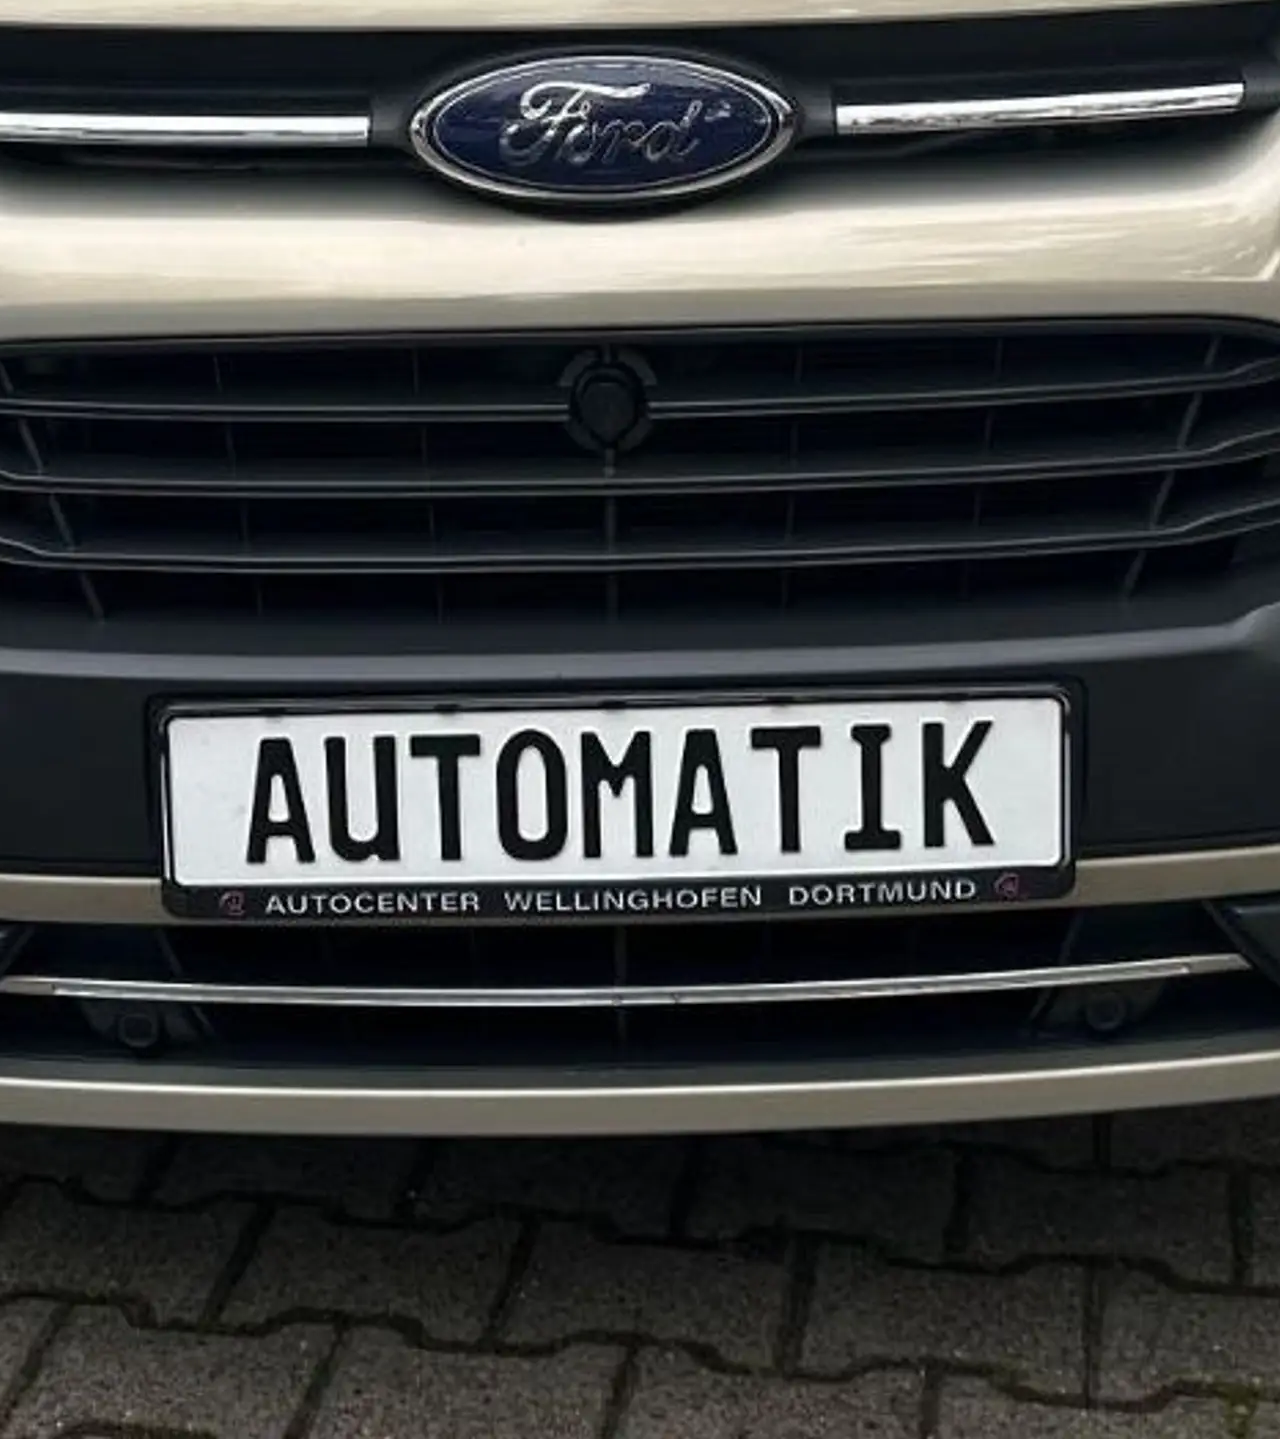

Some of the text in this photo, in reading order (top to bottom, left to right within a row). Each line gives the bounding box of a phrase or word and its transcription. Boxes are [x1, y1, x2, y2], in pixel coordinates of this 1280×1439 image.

[498, 79, 702, 166] Ford
[245, 719, 996, 865] AUTOMATIK
[264, 878, 977, 915] AUTOCENTER WELLINGHOFEN DORTMUND
